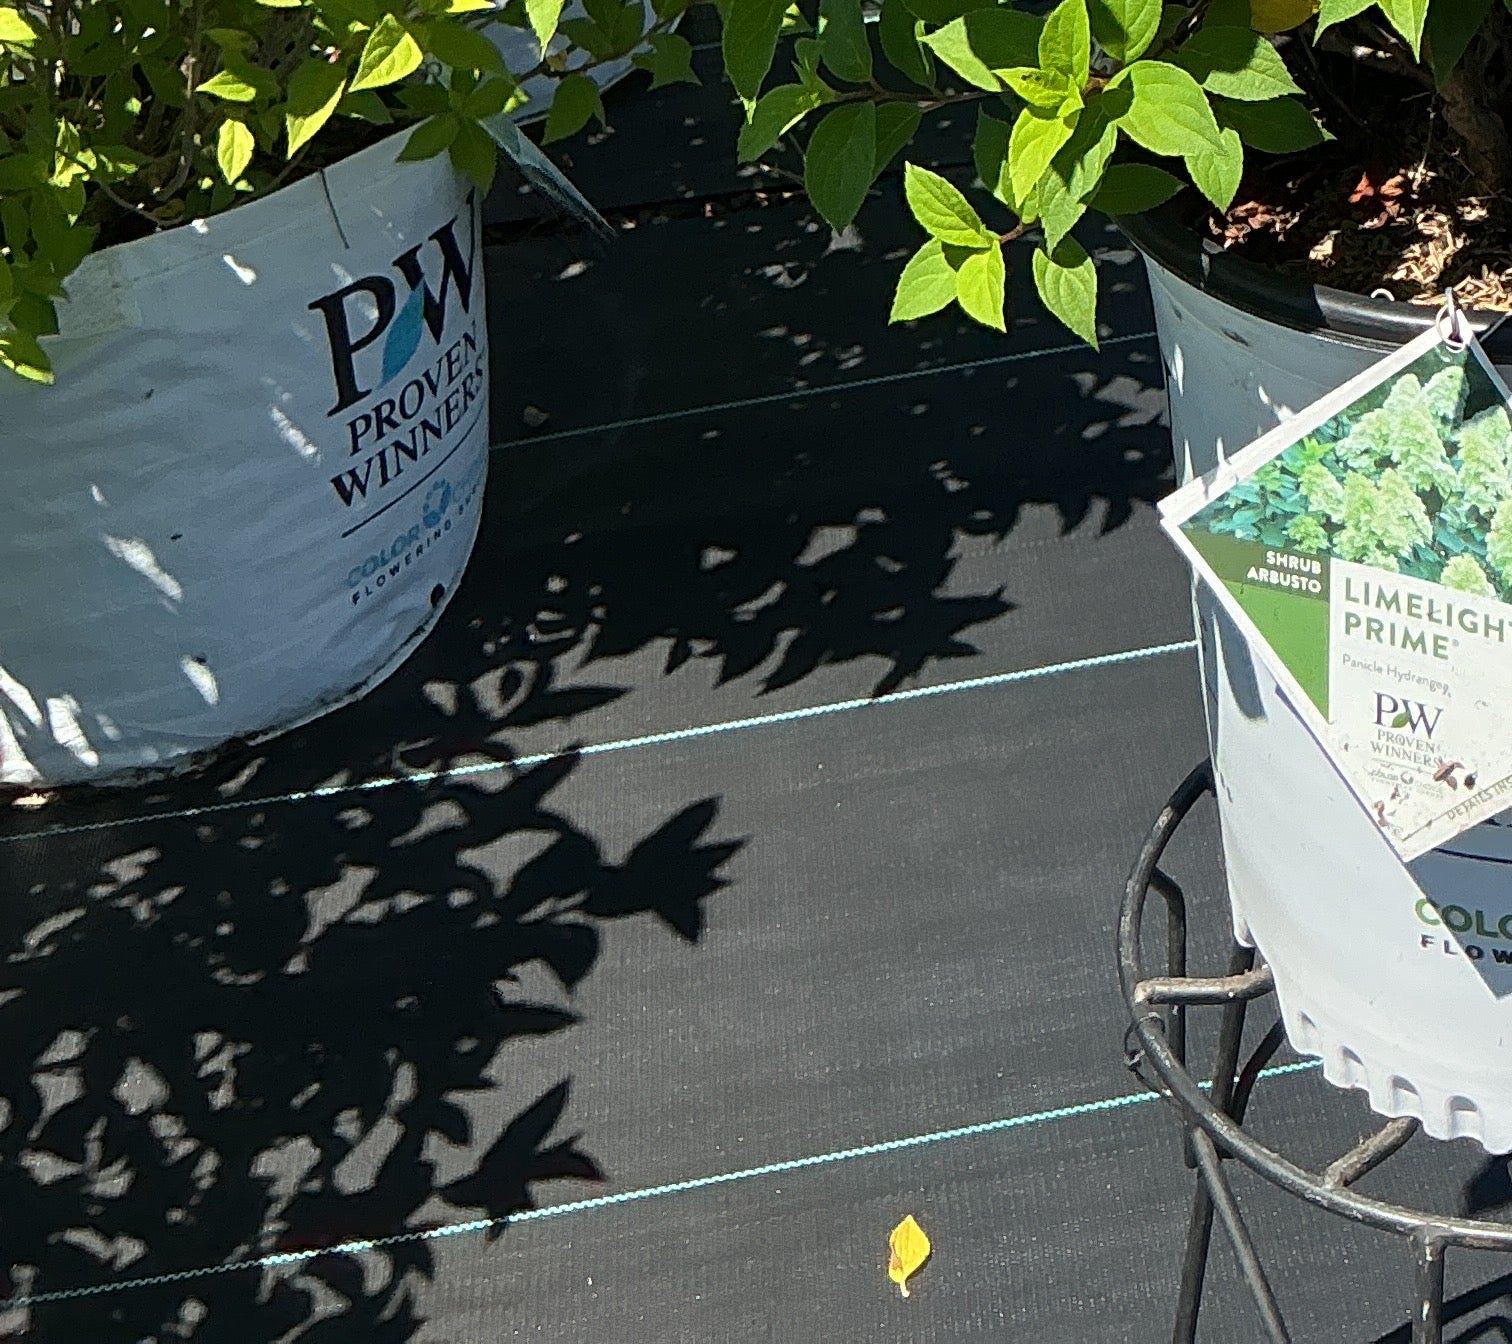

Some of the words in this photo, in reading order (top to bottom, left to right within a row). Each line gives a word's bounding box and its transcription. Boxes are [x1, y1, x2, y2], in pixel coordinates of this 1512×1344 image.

[308, 187, 476, 417] PW
[346, 320, 477, 456] PROVEN
[347, 523, 420, 589] COLOR
[1265, 549, 1322, 575] SHRUB
[1247, 566, 1322, 593] ARBUSTO
[1342, 653, 1384, 674] Panicle
[1371, 690, 1445, 739] PW
[1377, 728, 1437, 754] PROVEN
